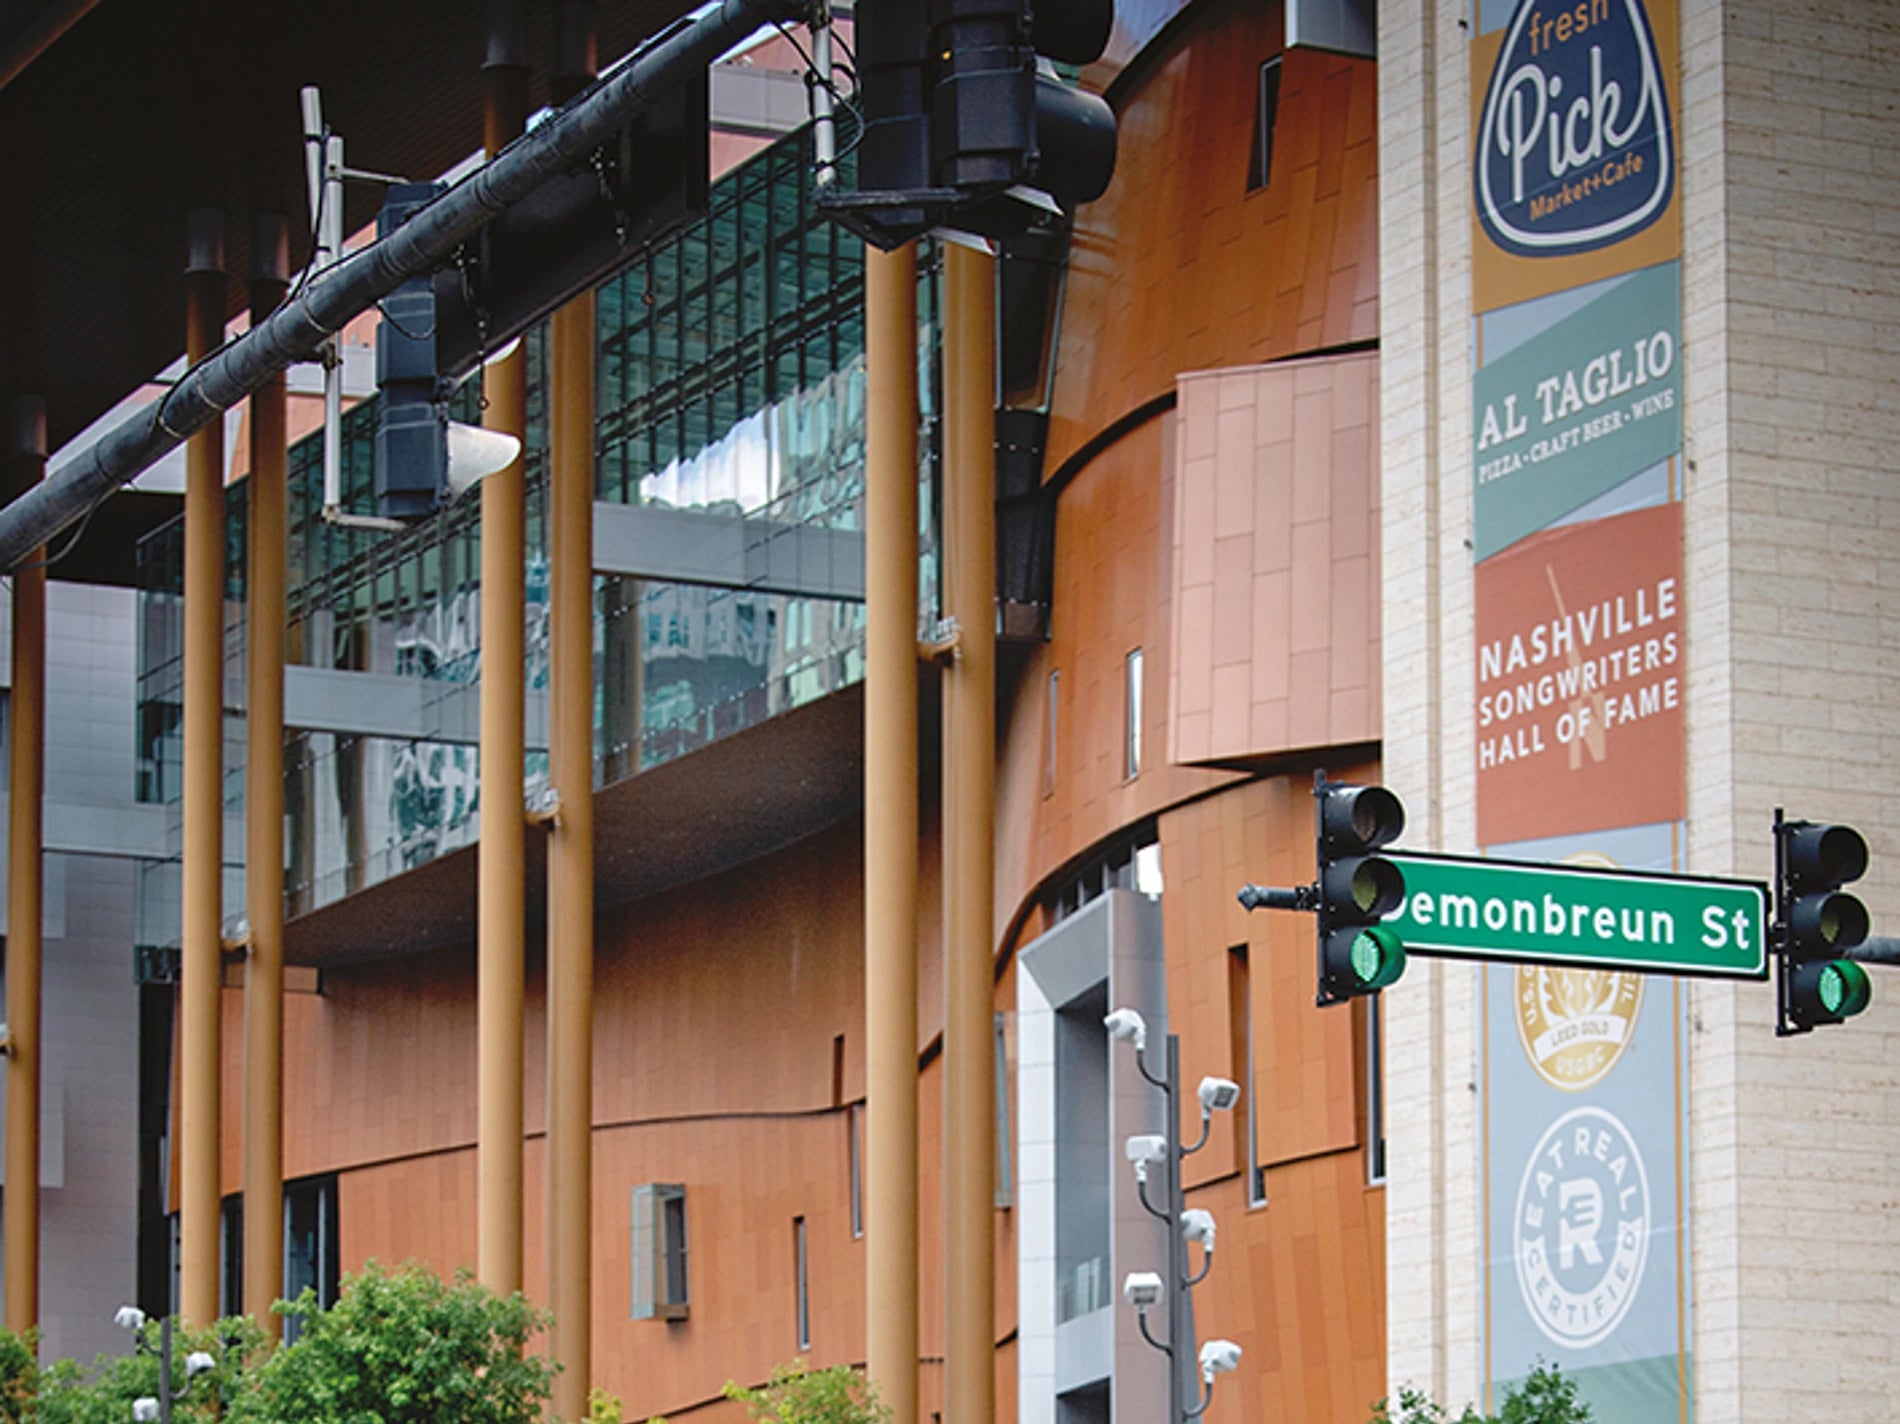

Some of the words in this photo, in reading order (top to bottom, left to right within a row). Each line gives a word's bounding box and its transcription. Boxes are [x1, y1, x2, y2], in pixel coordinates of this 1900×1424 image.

[1496, 45, 1650, 203] Pick
[1477, 394, 1528, 451] AL
[1536, 330, 1674, 425] TAGLIO
[1530, 428, 1581, 463] CRAFT
[1583, 411, 1624, 442] BEER
[1631, 388, 1675, 420] WINE
[1480, 578, 1676, 682] NASHVILLE
[1479, 632, 1678, 727] SONGWRITERS
[1479, 725, 1545, 769] HALL
[1556, 707, 1592, 744] OF
[1604, 678, 1678, 729] FAME
[1700, 905, 1750, 950] St
[1525, 1141, 1564, 1229] EAT
[1575, 1127, 1638, 1212] REAL
[1527, 1231, 1637, 1326] CERTIFIED
